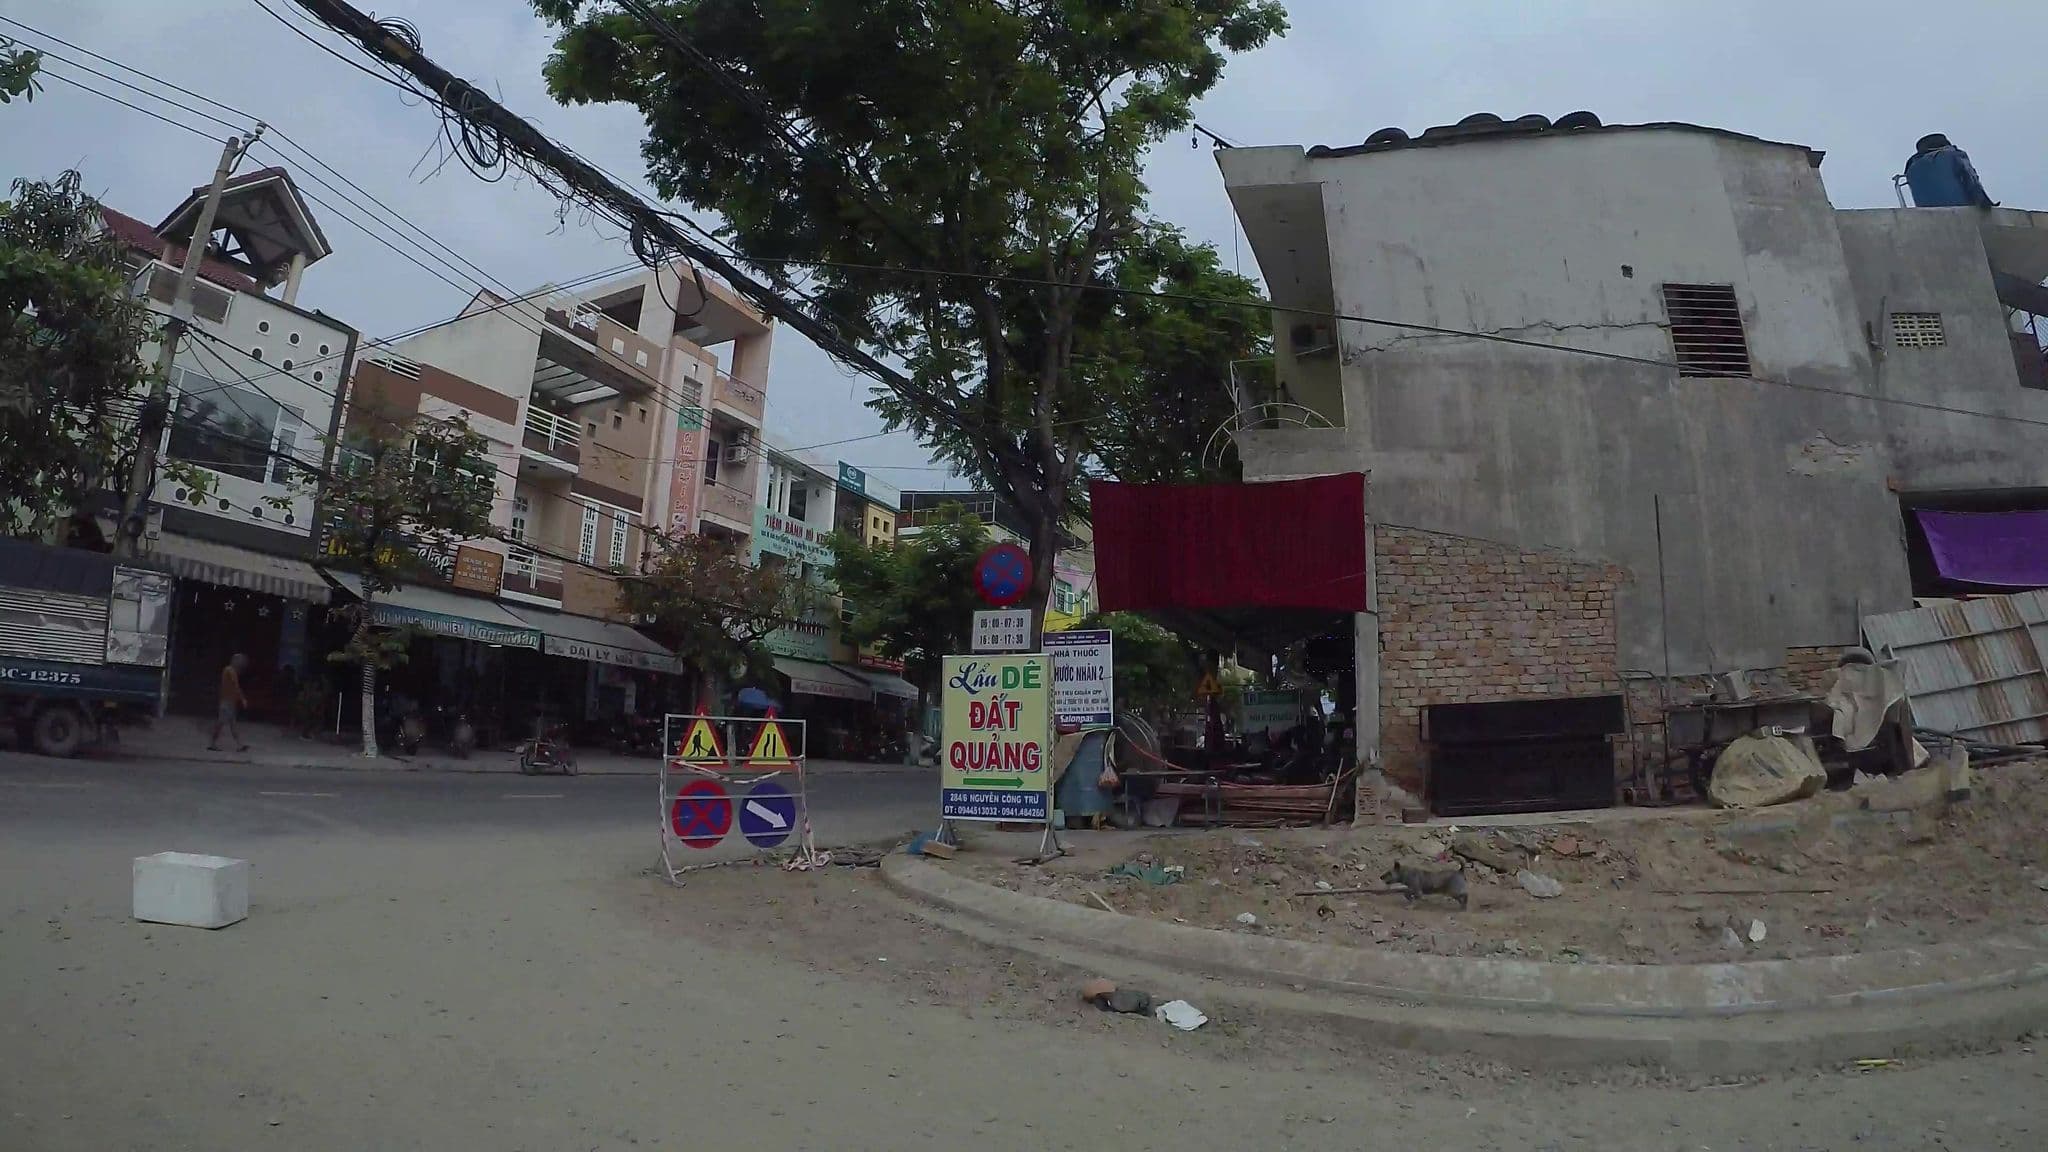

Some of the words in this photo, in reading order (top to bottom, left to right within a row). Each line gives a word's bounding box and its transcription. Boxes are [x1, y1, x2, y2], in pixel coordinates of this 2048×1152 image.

[1002, 659, 1041, 689] DÊ
[969, 693, 1022, 730] ĐẤT
[949, 733, 1041, 773] QUẢNG
